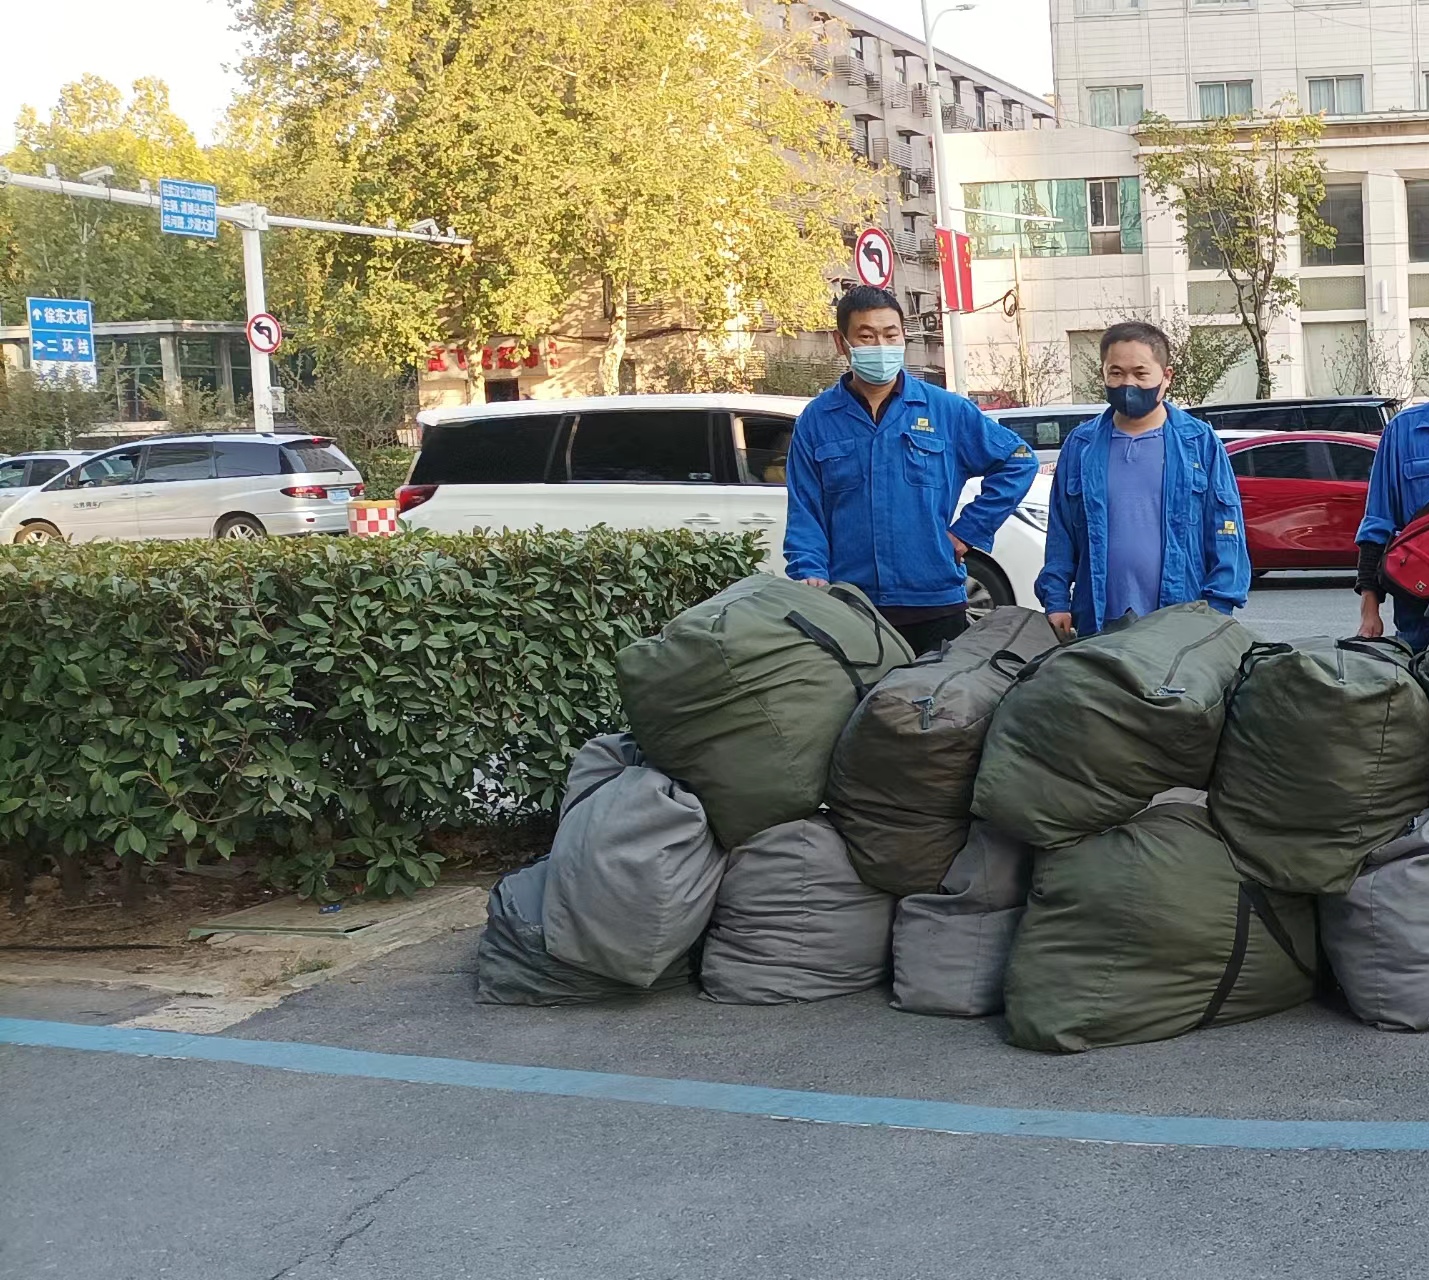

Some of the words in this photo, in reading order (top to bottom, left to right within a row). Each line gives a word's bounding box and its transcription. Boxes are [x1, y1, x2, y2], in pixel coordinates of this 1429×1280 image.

[44, 307, 87, 325] 徐东大街
[47, 338, 89, 355] 二环线
